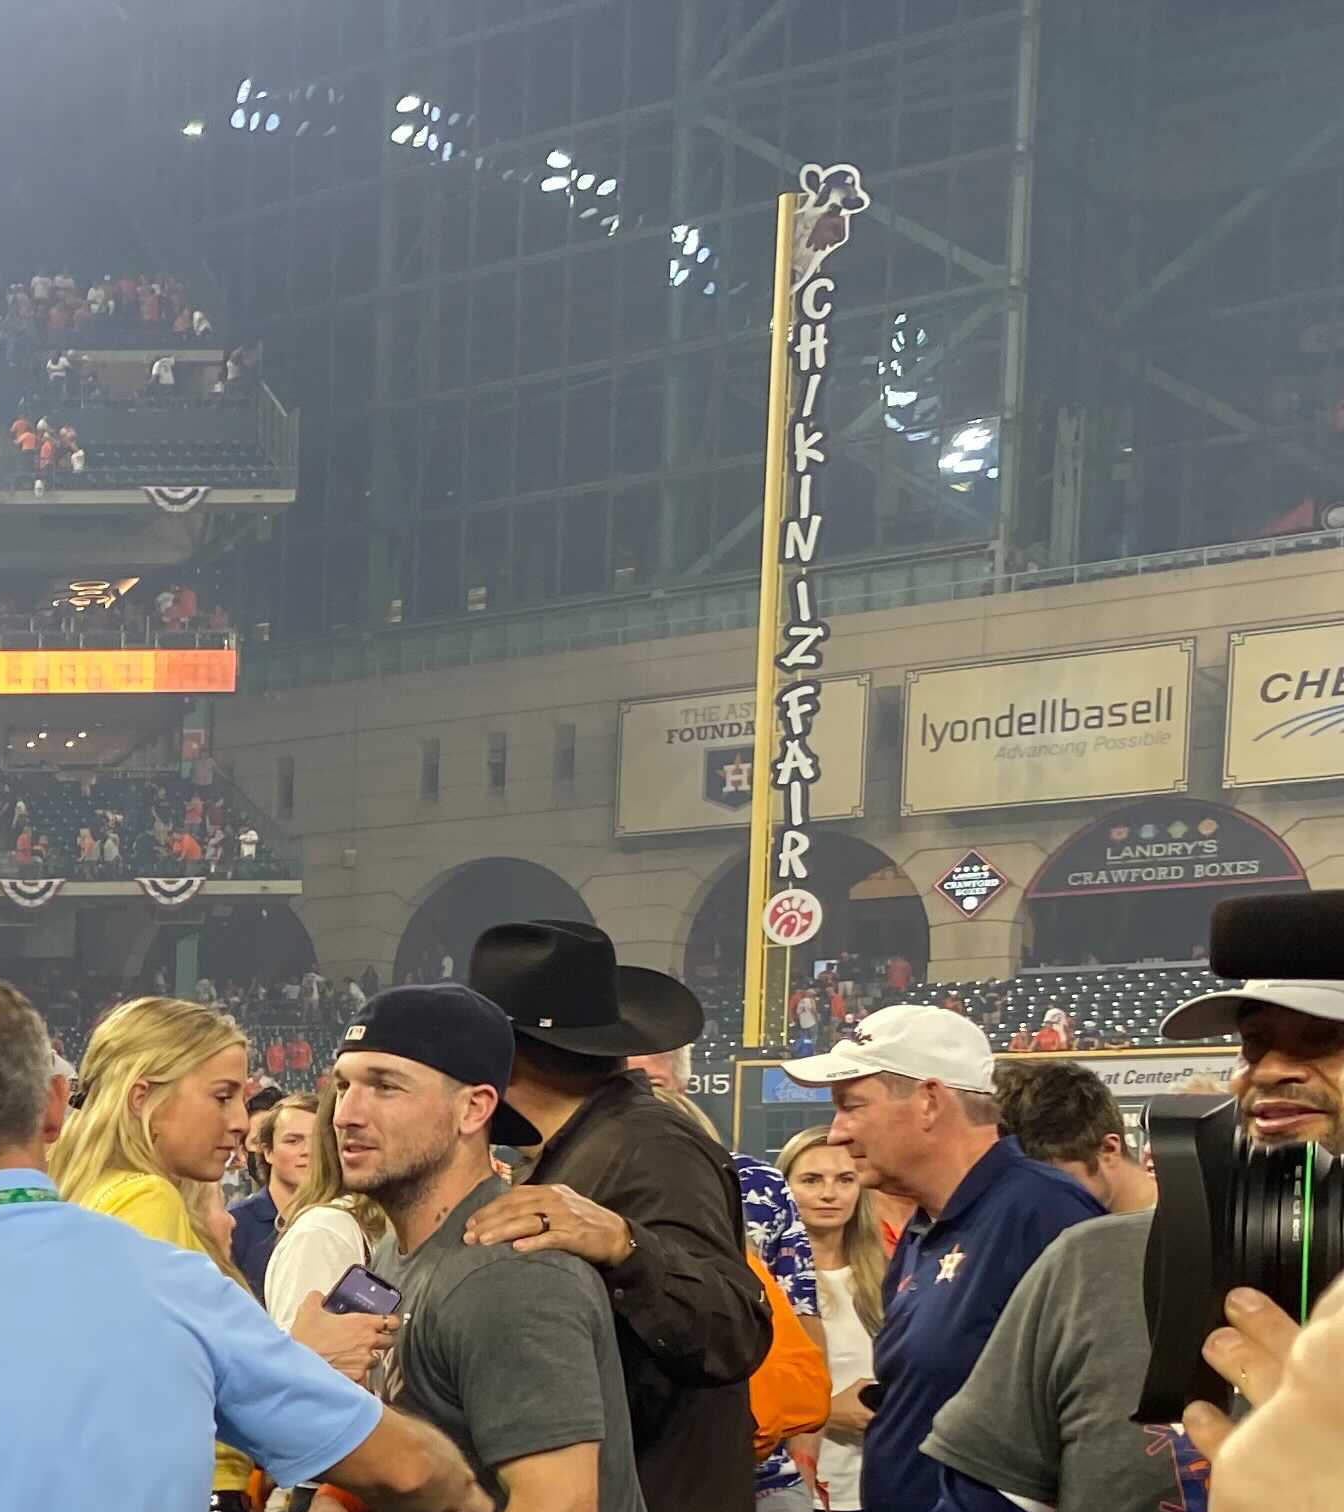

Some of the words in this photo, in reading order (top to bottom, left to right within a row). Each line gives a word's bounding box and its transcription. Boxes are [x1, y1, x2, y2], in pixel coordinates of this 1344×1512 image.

[784, 277, 835, 562] CHIKIN
[779, 580, 825, 666] IZ
[680, 705, 720, 725] THE
[920, 686, 1173, 753] lyondellbasell
[666, 720, 756, 744] FOUNDA
[994, 738, 1088, 760] Advancing
[1093, 731, 1171, 750] Possible
[776, 685, 815, 878] FAIR
[1106, 839, 1218, 861] LANDRY'S
[1067, 866, 1184, 886] CRAWFORD
[1193, 860, 1260, 878] BOXES
[685, 1073, 730, 1095] 315
